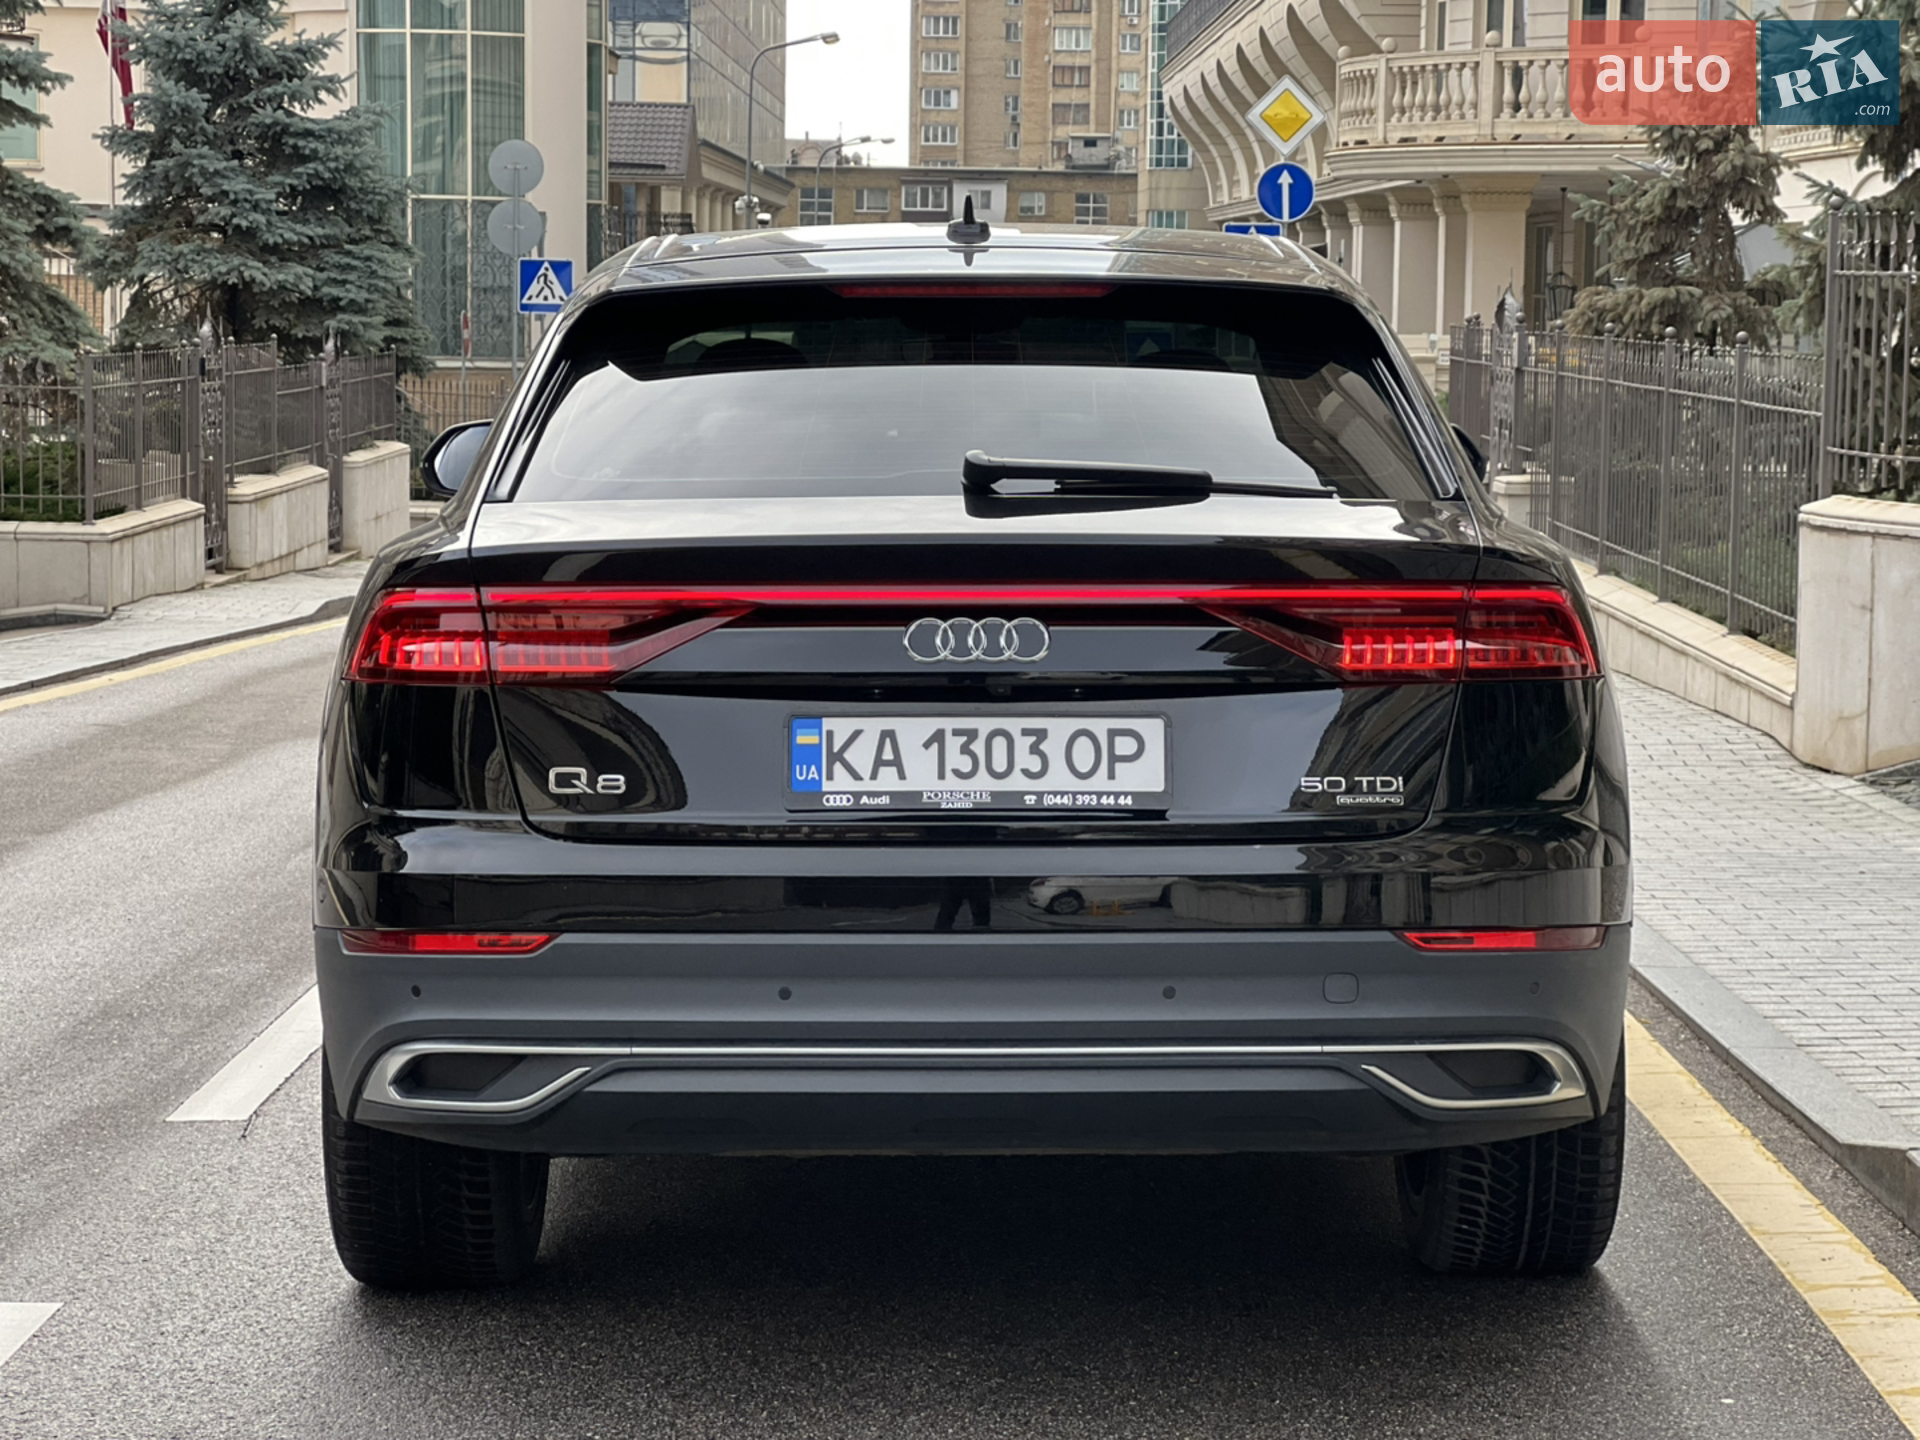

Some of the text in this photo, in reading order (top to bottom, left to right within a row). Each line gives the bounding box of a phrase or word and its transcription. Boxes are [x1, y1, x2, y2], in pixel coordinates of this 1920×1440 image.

[826, 728, 1145, 781] KA 1303 OP
[796, 764, 820, 781] UA
[548, 766, 626, 794] Q8
[1300, 776, 1404, 792] 50 TDI
[859, 795, 890, 805] Audi
[922, 791, 992, 800] PORSCHE
[1043, 793, 1133, 806] (044) 393 44 44
[1339, 796, 1402, 805] quattro
